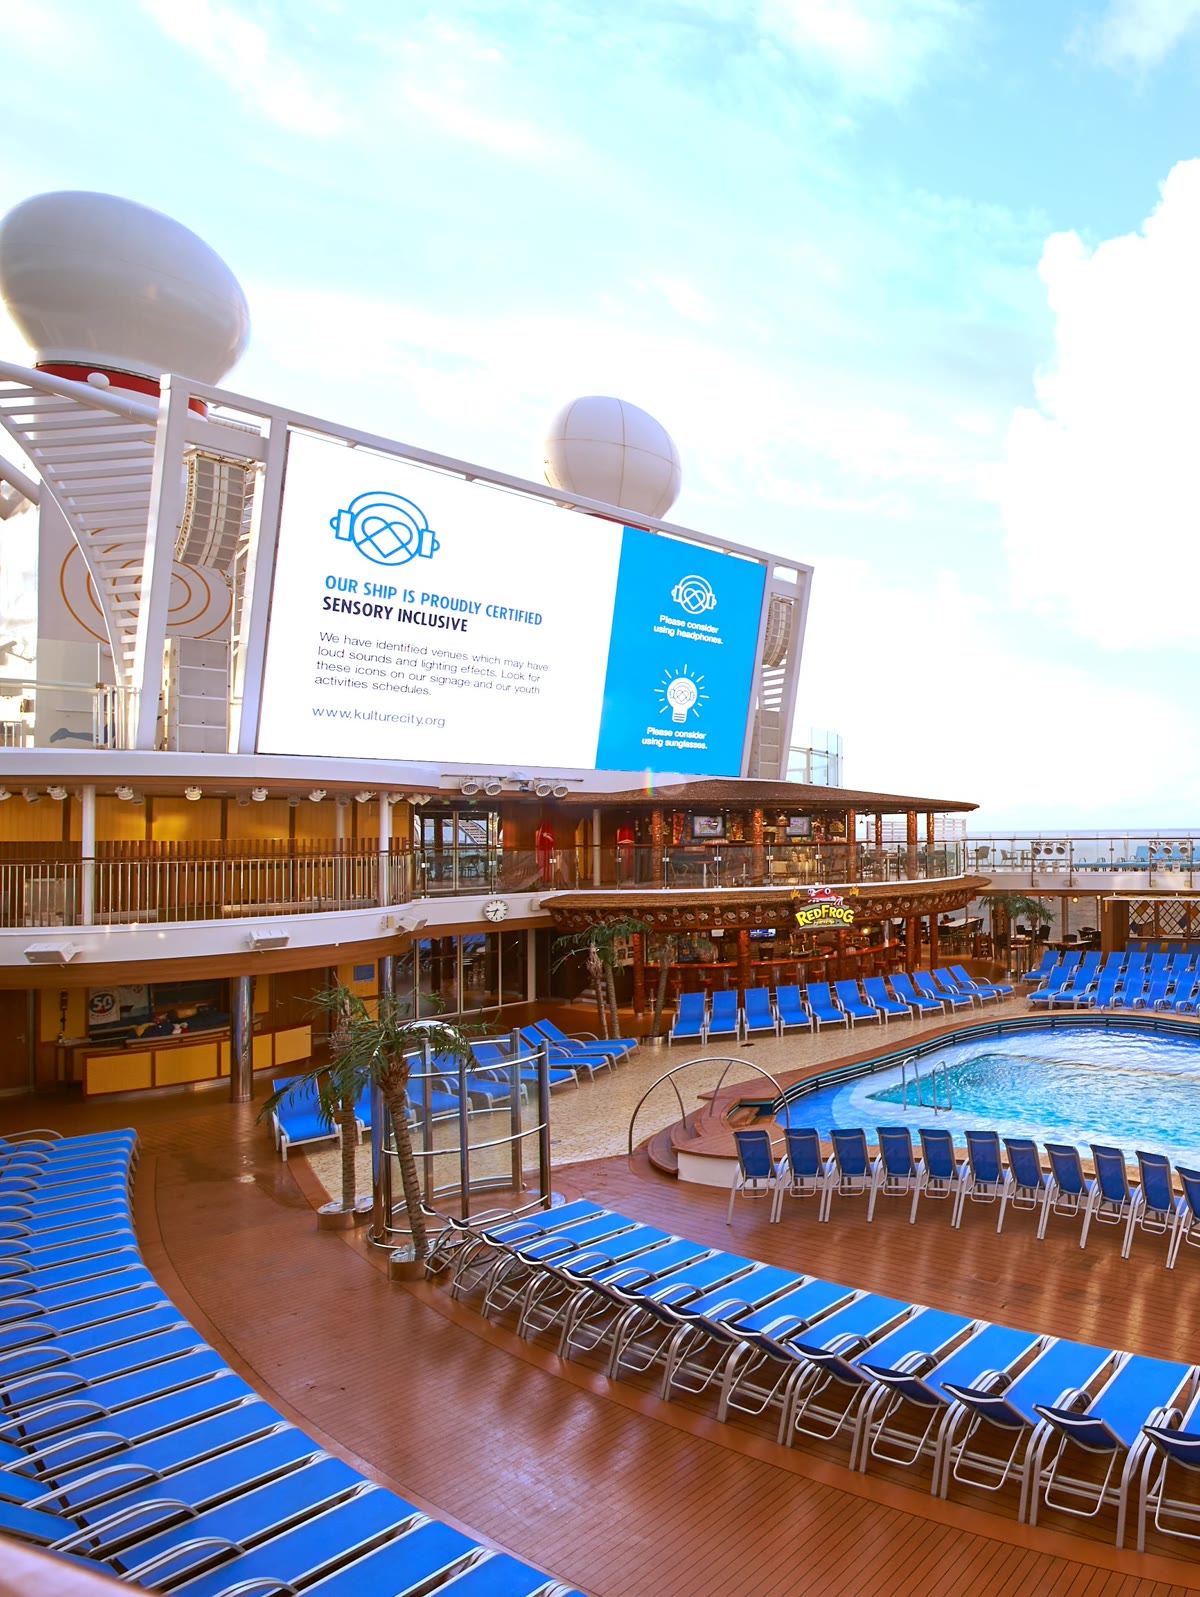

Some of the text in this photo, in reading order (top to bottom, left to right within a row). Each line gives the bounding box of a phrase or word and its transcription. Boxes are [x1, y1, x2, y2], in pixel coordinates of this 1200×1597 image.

[325, 575, 542, 625] OUR SHIP IS PROUDLY CERTIFIED
[323, 597, 468, 632] SENSORY INCLUSIVE
[660, 615, 719, 633] Please consider
[654, 625, 723, 644] using headphones.
[319, 632, 548, 671] We have identified venues which may have
[318, 646, 540, 682] loud sounds and lighting effects. Look for
[315, 675, 432, 695] activities schedules.
[317, 661, 540, 694] these icons on our signage and our youth
[312, 707, 445, 728] www.kulturecity.org
[642, 738, 707, 749] using sunglasses.
[647, 727, 706, 739] Please consider
